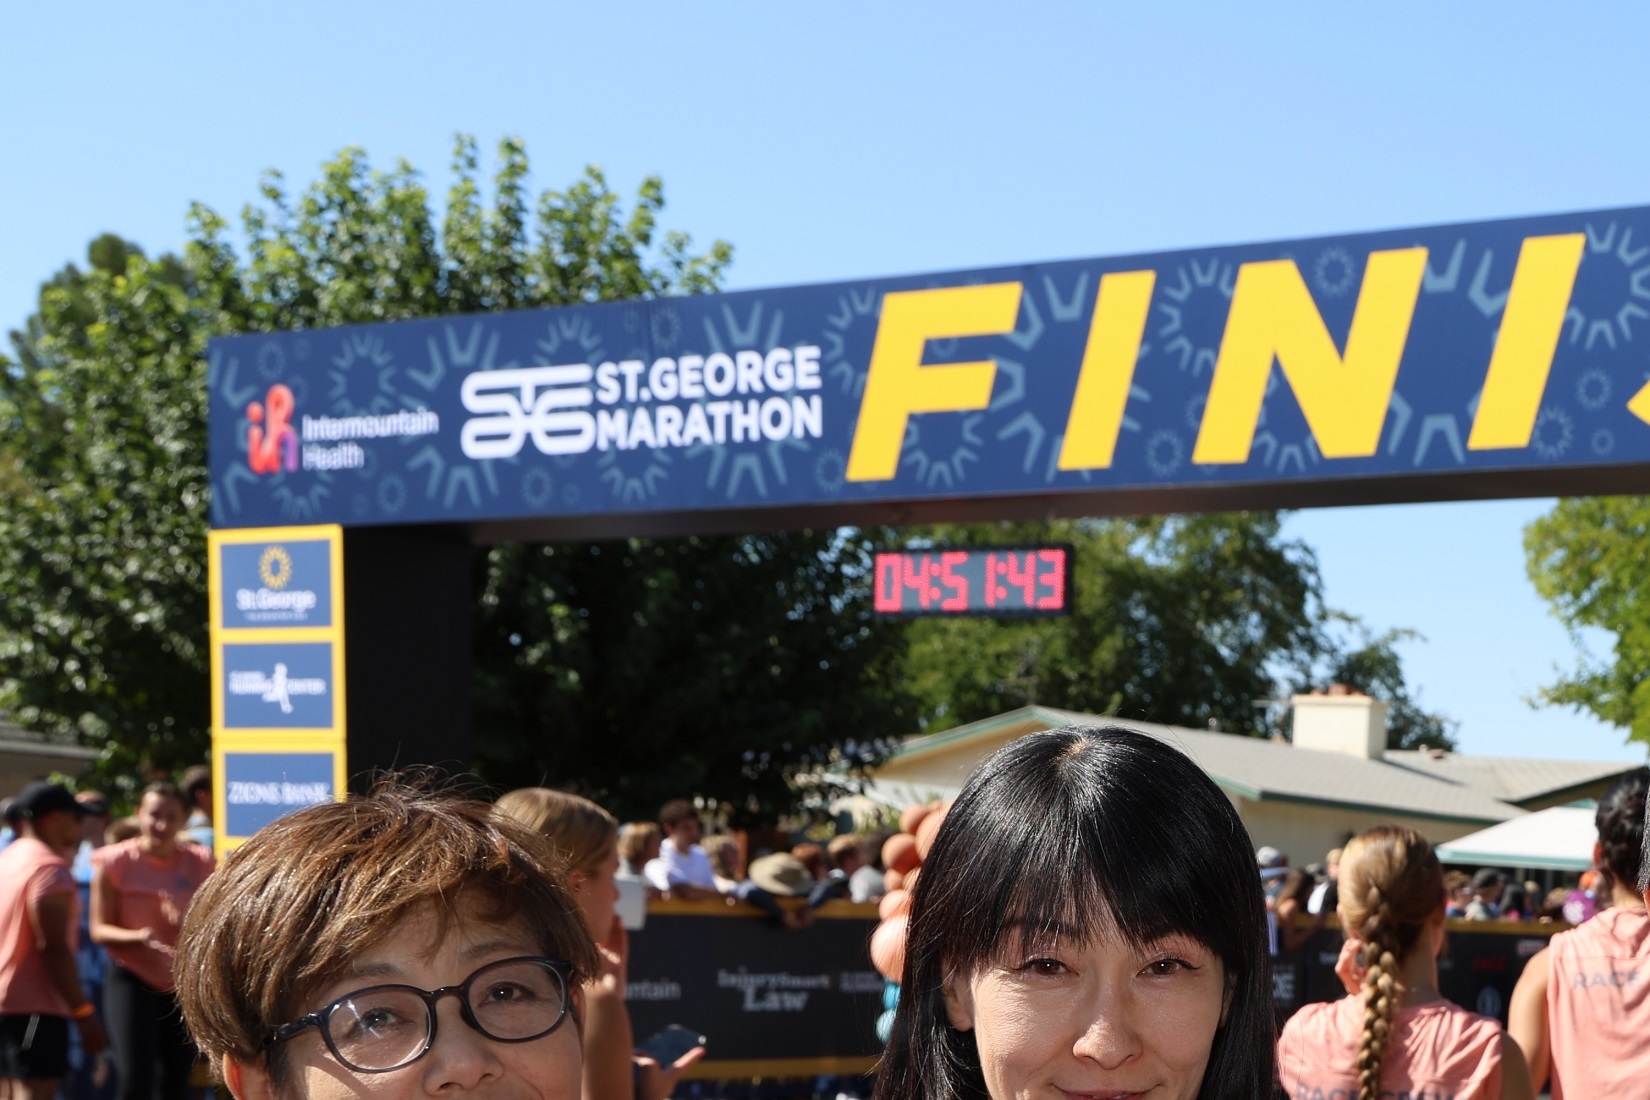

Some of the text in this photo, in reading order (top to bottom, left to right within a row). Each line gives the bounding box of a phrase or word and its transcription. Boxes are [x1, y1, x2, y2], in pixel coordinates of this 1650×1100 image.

[596, 345, 823, 405] ST.GEORGE
[302, 406, 439, 442] Intermountain
[595, 395, 823, 450] MARATHON
[302, 444, 364, 472] Health
[742, 986, 809, 1012] Law
